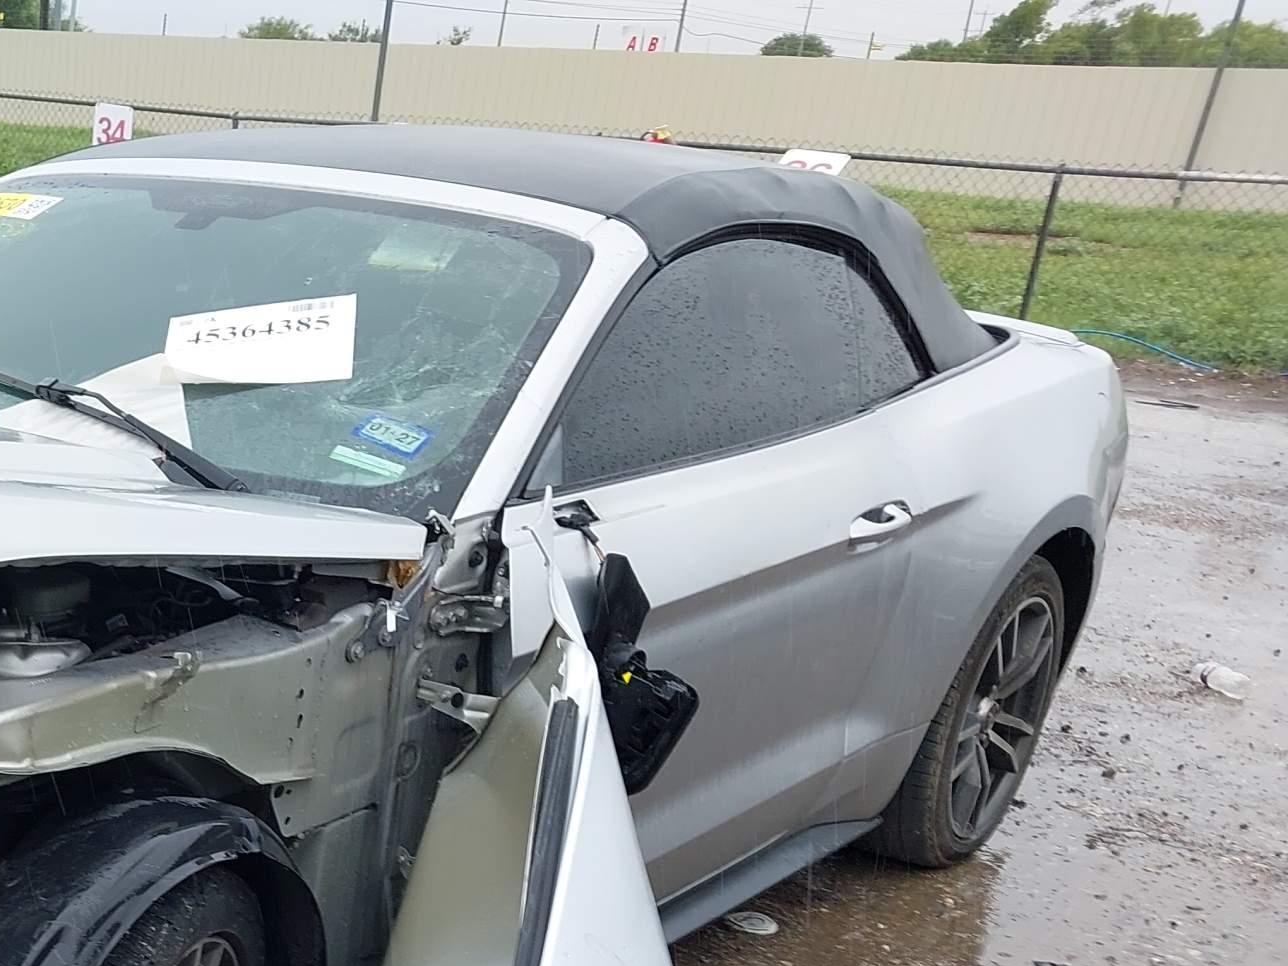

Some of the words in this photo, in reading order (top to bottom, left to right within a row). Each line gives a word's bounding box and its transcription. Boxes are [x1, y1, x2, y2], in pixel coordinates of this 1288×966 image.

[626, 36, 637, 51] A
[647, 36, 659, 52] B
[96, 117, 126, 144] 34
[187, 315, 331, 344] 45364385
